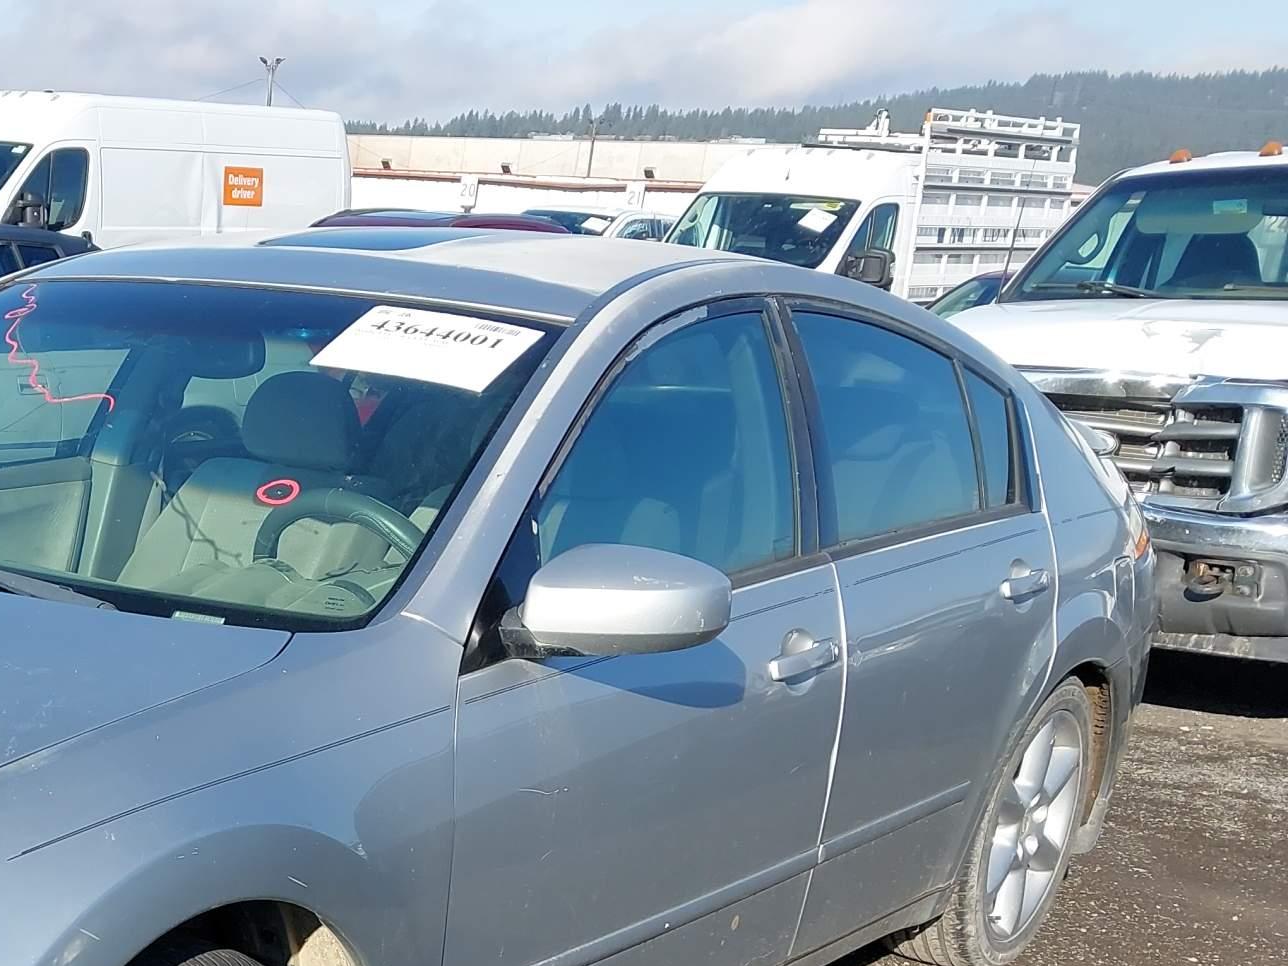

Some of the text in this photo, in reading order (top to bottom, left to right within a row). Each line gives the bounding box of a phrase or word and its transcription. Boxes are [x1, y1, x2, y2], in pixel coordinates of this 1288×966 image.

[228, 173, 259, 188] Delivery
[231, 187, 256, 199] driver
[460, 183, 475, 197] 20
[627, 190, 641, 206] 21
[370, 319, 505, 349] 43644001
